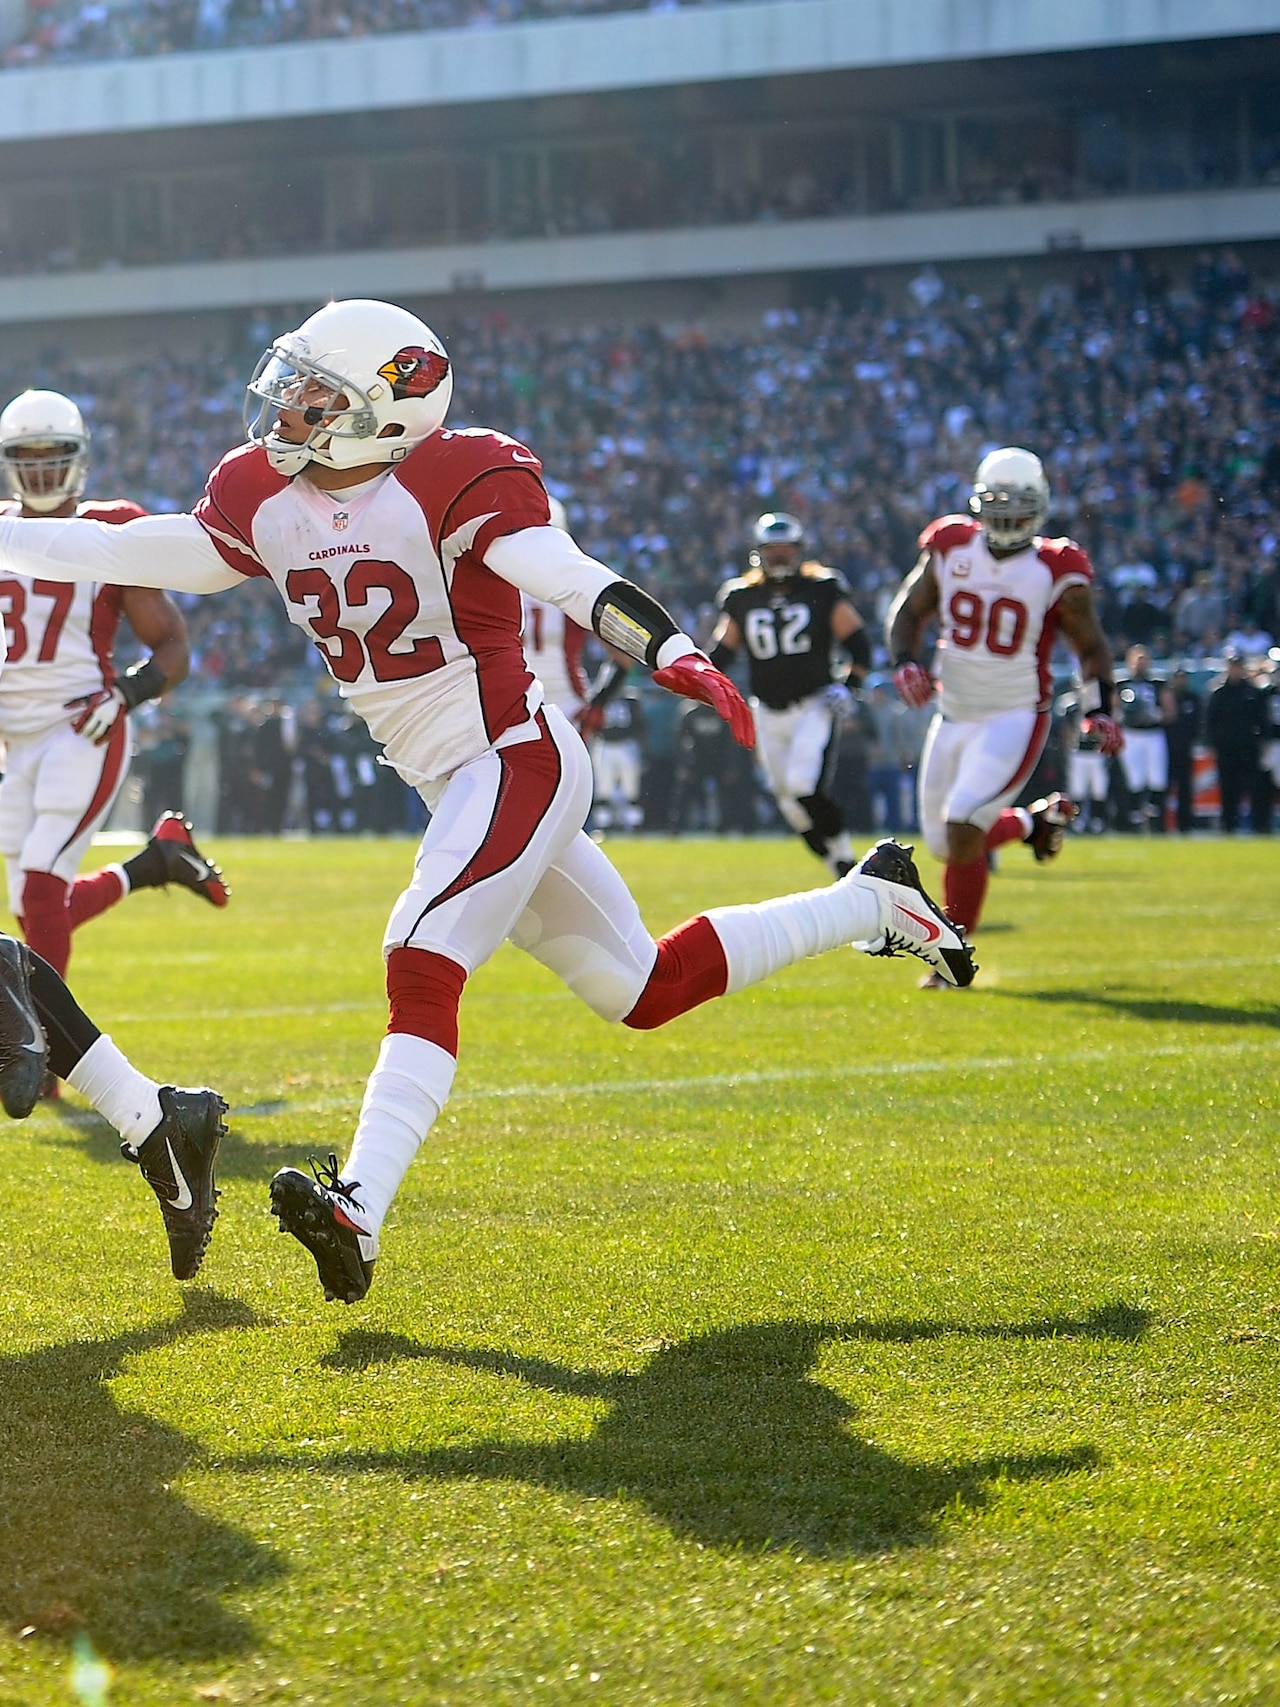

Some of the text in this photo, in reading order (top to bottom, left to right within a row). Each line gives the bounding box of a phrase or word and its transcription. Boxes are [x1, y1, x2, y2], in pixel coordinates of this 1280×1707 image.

[309, 544, 371, 561] CARDINALS
[286, 559, 447, 683] 32
[745, 602, 812, 661] 62
[950, 591, 1028, 656] 90
